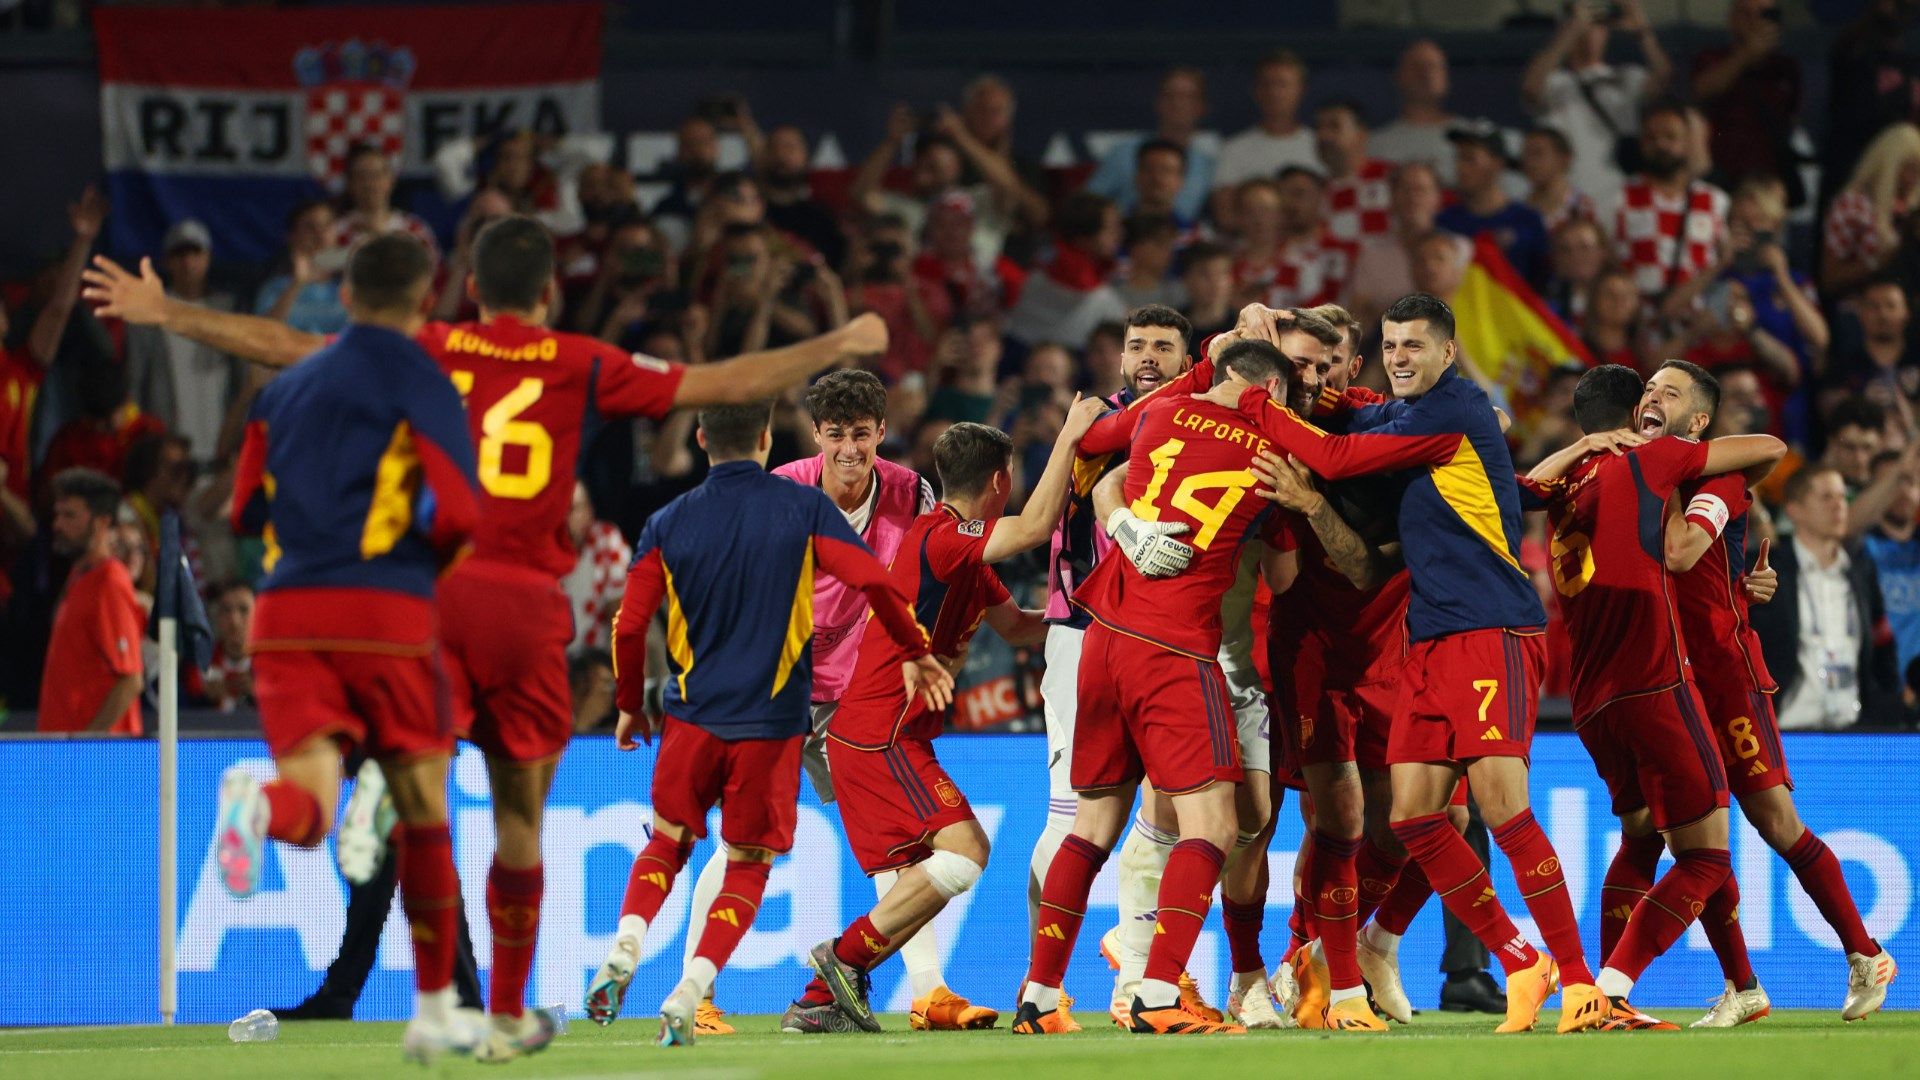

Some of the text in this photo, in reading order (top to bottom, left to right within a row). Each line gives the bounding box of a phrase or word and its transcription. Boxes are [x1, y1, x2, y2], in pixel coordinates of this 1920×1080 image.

[138, 99, 290, 162] RIJ
[1173, 408, 1271, 456] LAPORTE
[1130, 437, 1259, 551] 14
[1134, 534, 1155, 566] reusch
[1163, 539, 1192, 556] reusch
[1472, 679, 1498, 722] 7
